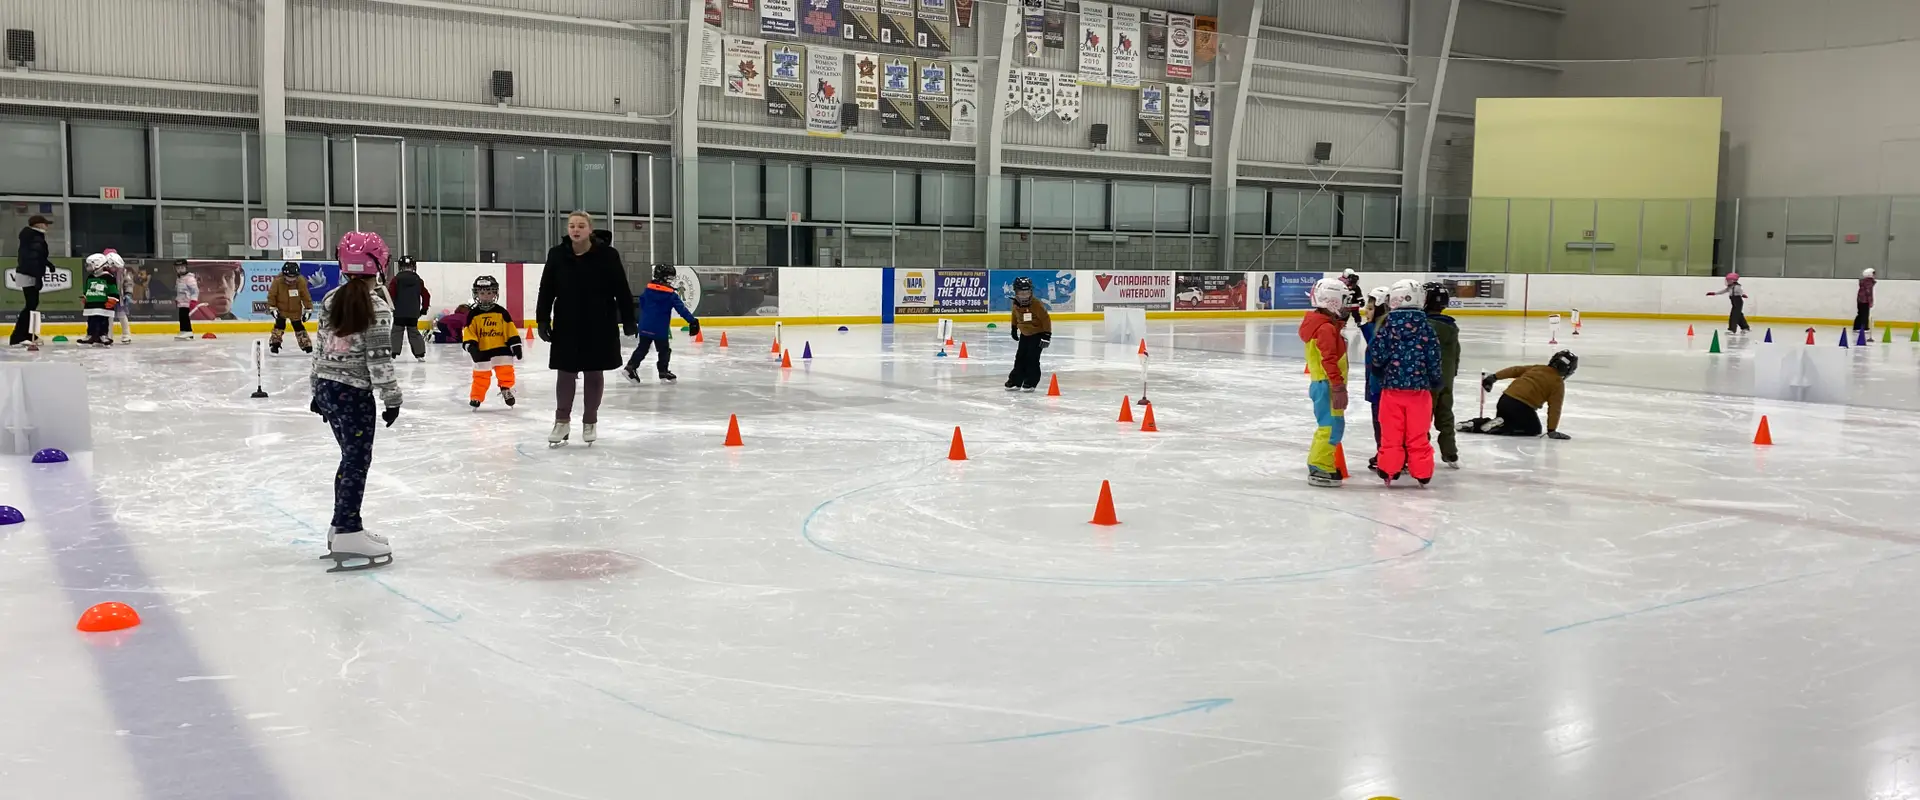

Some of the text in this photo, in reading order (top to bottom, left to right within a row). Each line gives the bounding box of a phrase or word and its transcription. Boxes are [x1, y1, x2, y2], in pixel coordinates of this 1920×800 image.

[844, 4, 876, 12] CHAMPIONS
[882, 8, 912, 17] CHAMPIONS
[919, 12, 948, 21] CHAMPIONS
[769, 80, 803, 88] CHAMPIONS
[104, 187, 120, 199] EXIT
[906, 278, 923, 288] NAPA
[943, 277, 980, 287] OPEN TO
[1113, 276, 1170, 285] CANADIAN TIRE
[937, 288, 986, 297] THE PUBLIC
[1120, 289, 1165, 298] WATERDOWN
[482, 316, 497, 326] Tim
[479, 328, 504, 338] Hortons
